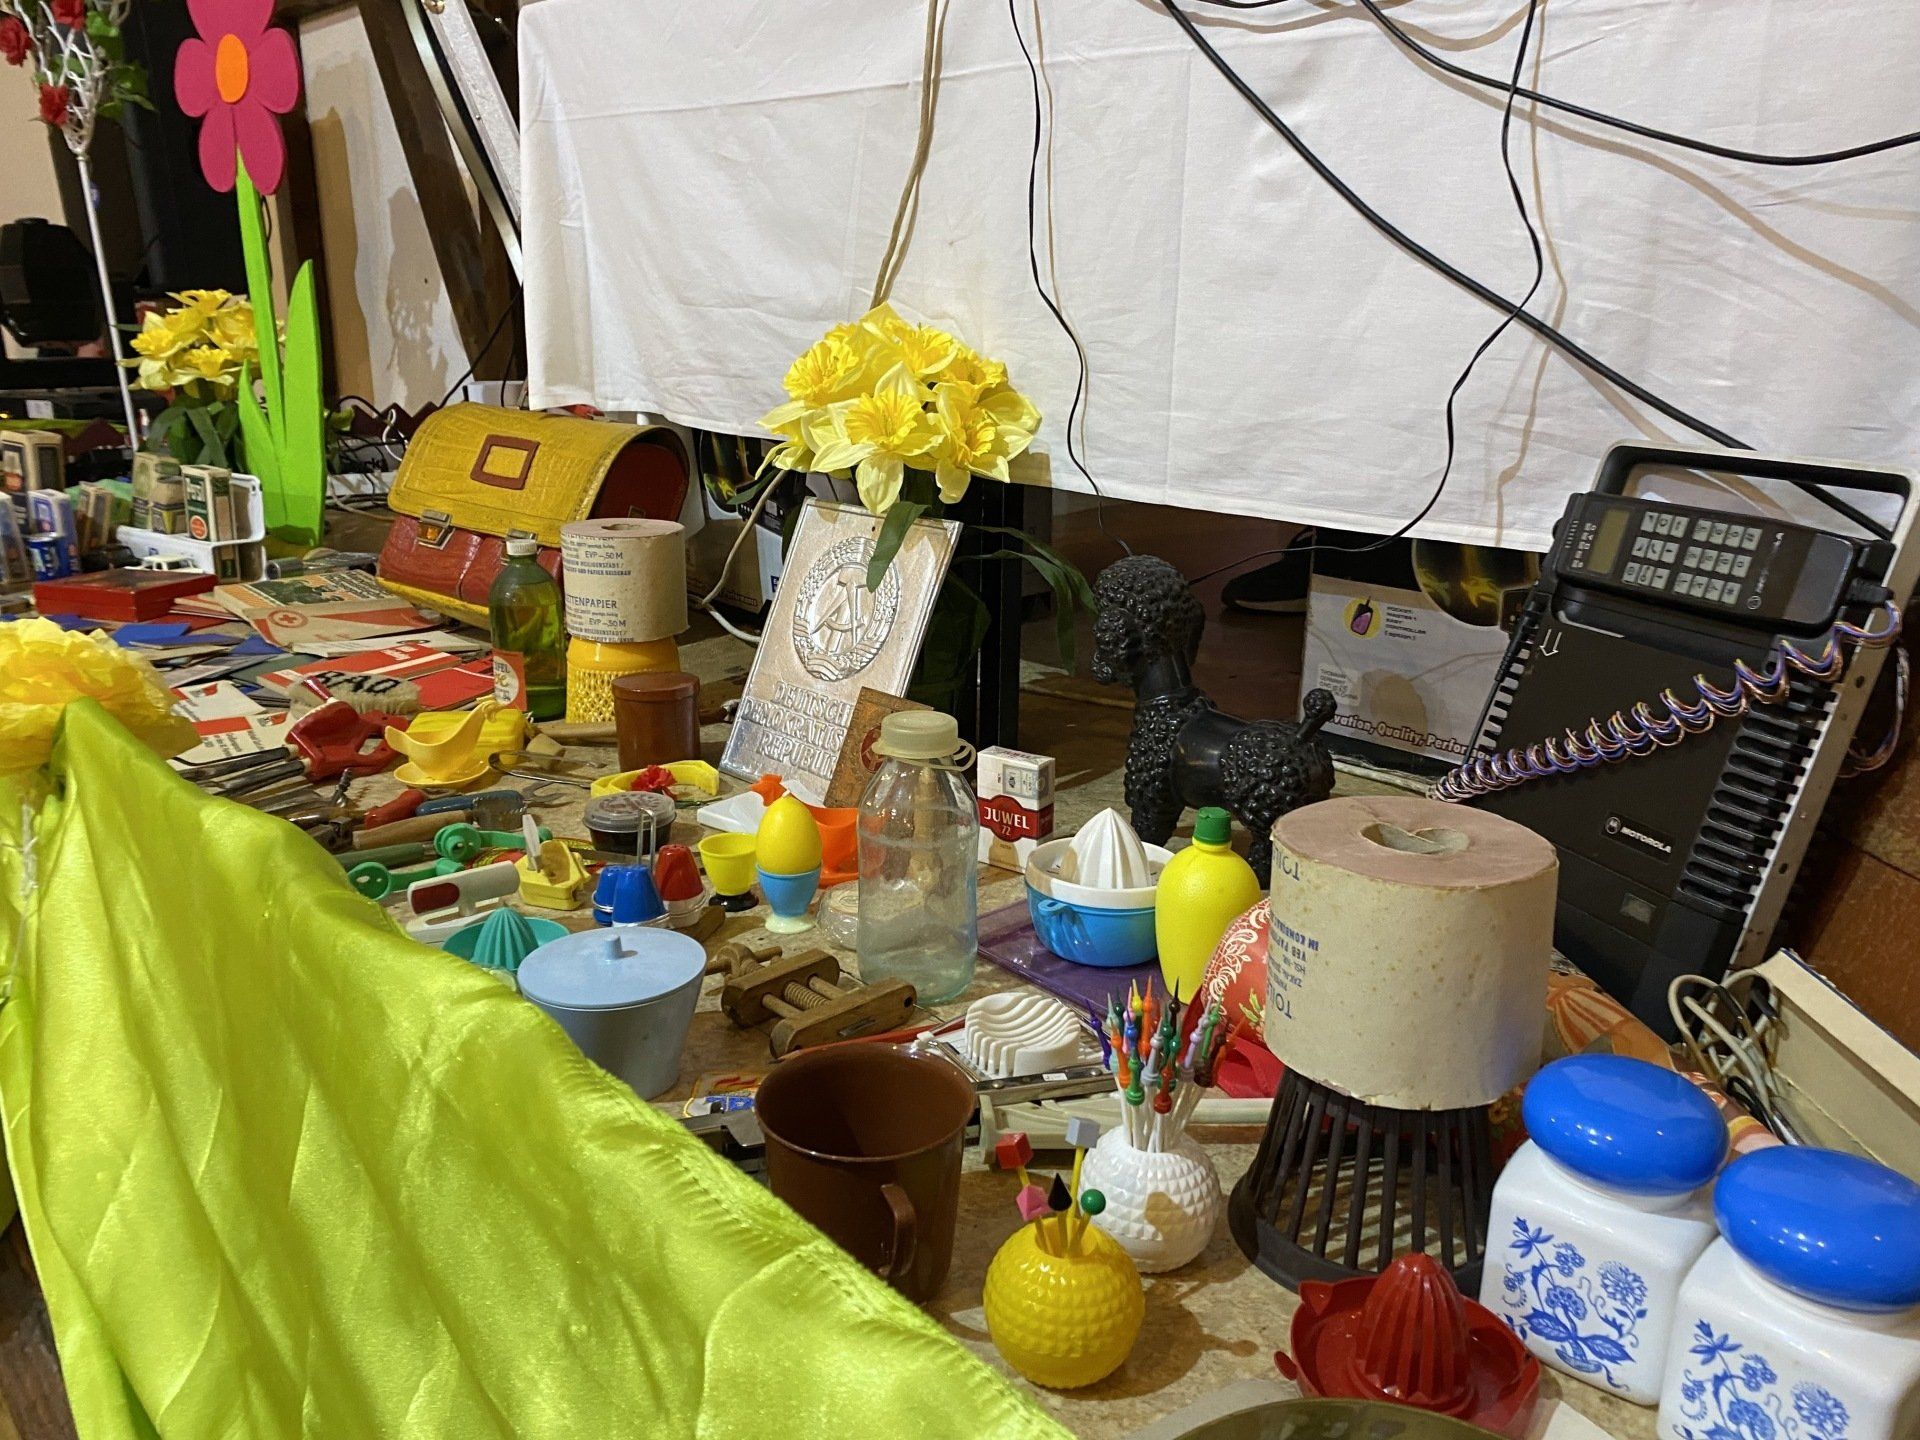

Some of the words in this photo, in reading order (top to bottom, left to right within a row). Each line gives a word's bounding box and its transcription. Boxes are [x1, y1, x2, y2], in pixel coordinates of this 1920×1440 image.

[772, 681, 854, 728] DEUTSCH
[741, 696, 846, 753] DEMOKRATIS
[1331, 714, 1376, 734] vation,
[984, 806, 1030, 829] JUWEL
[1620, 826, 1672, 853] MOTOROLA
